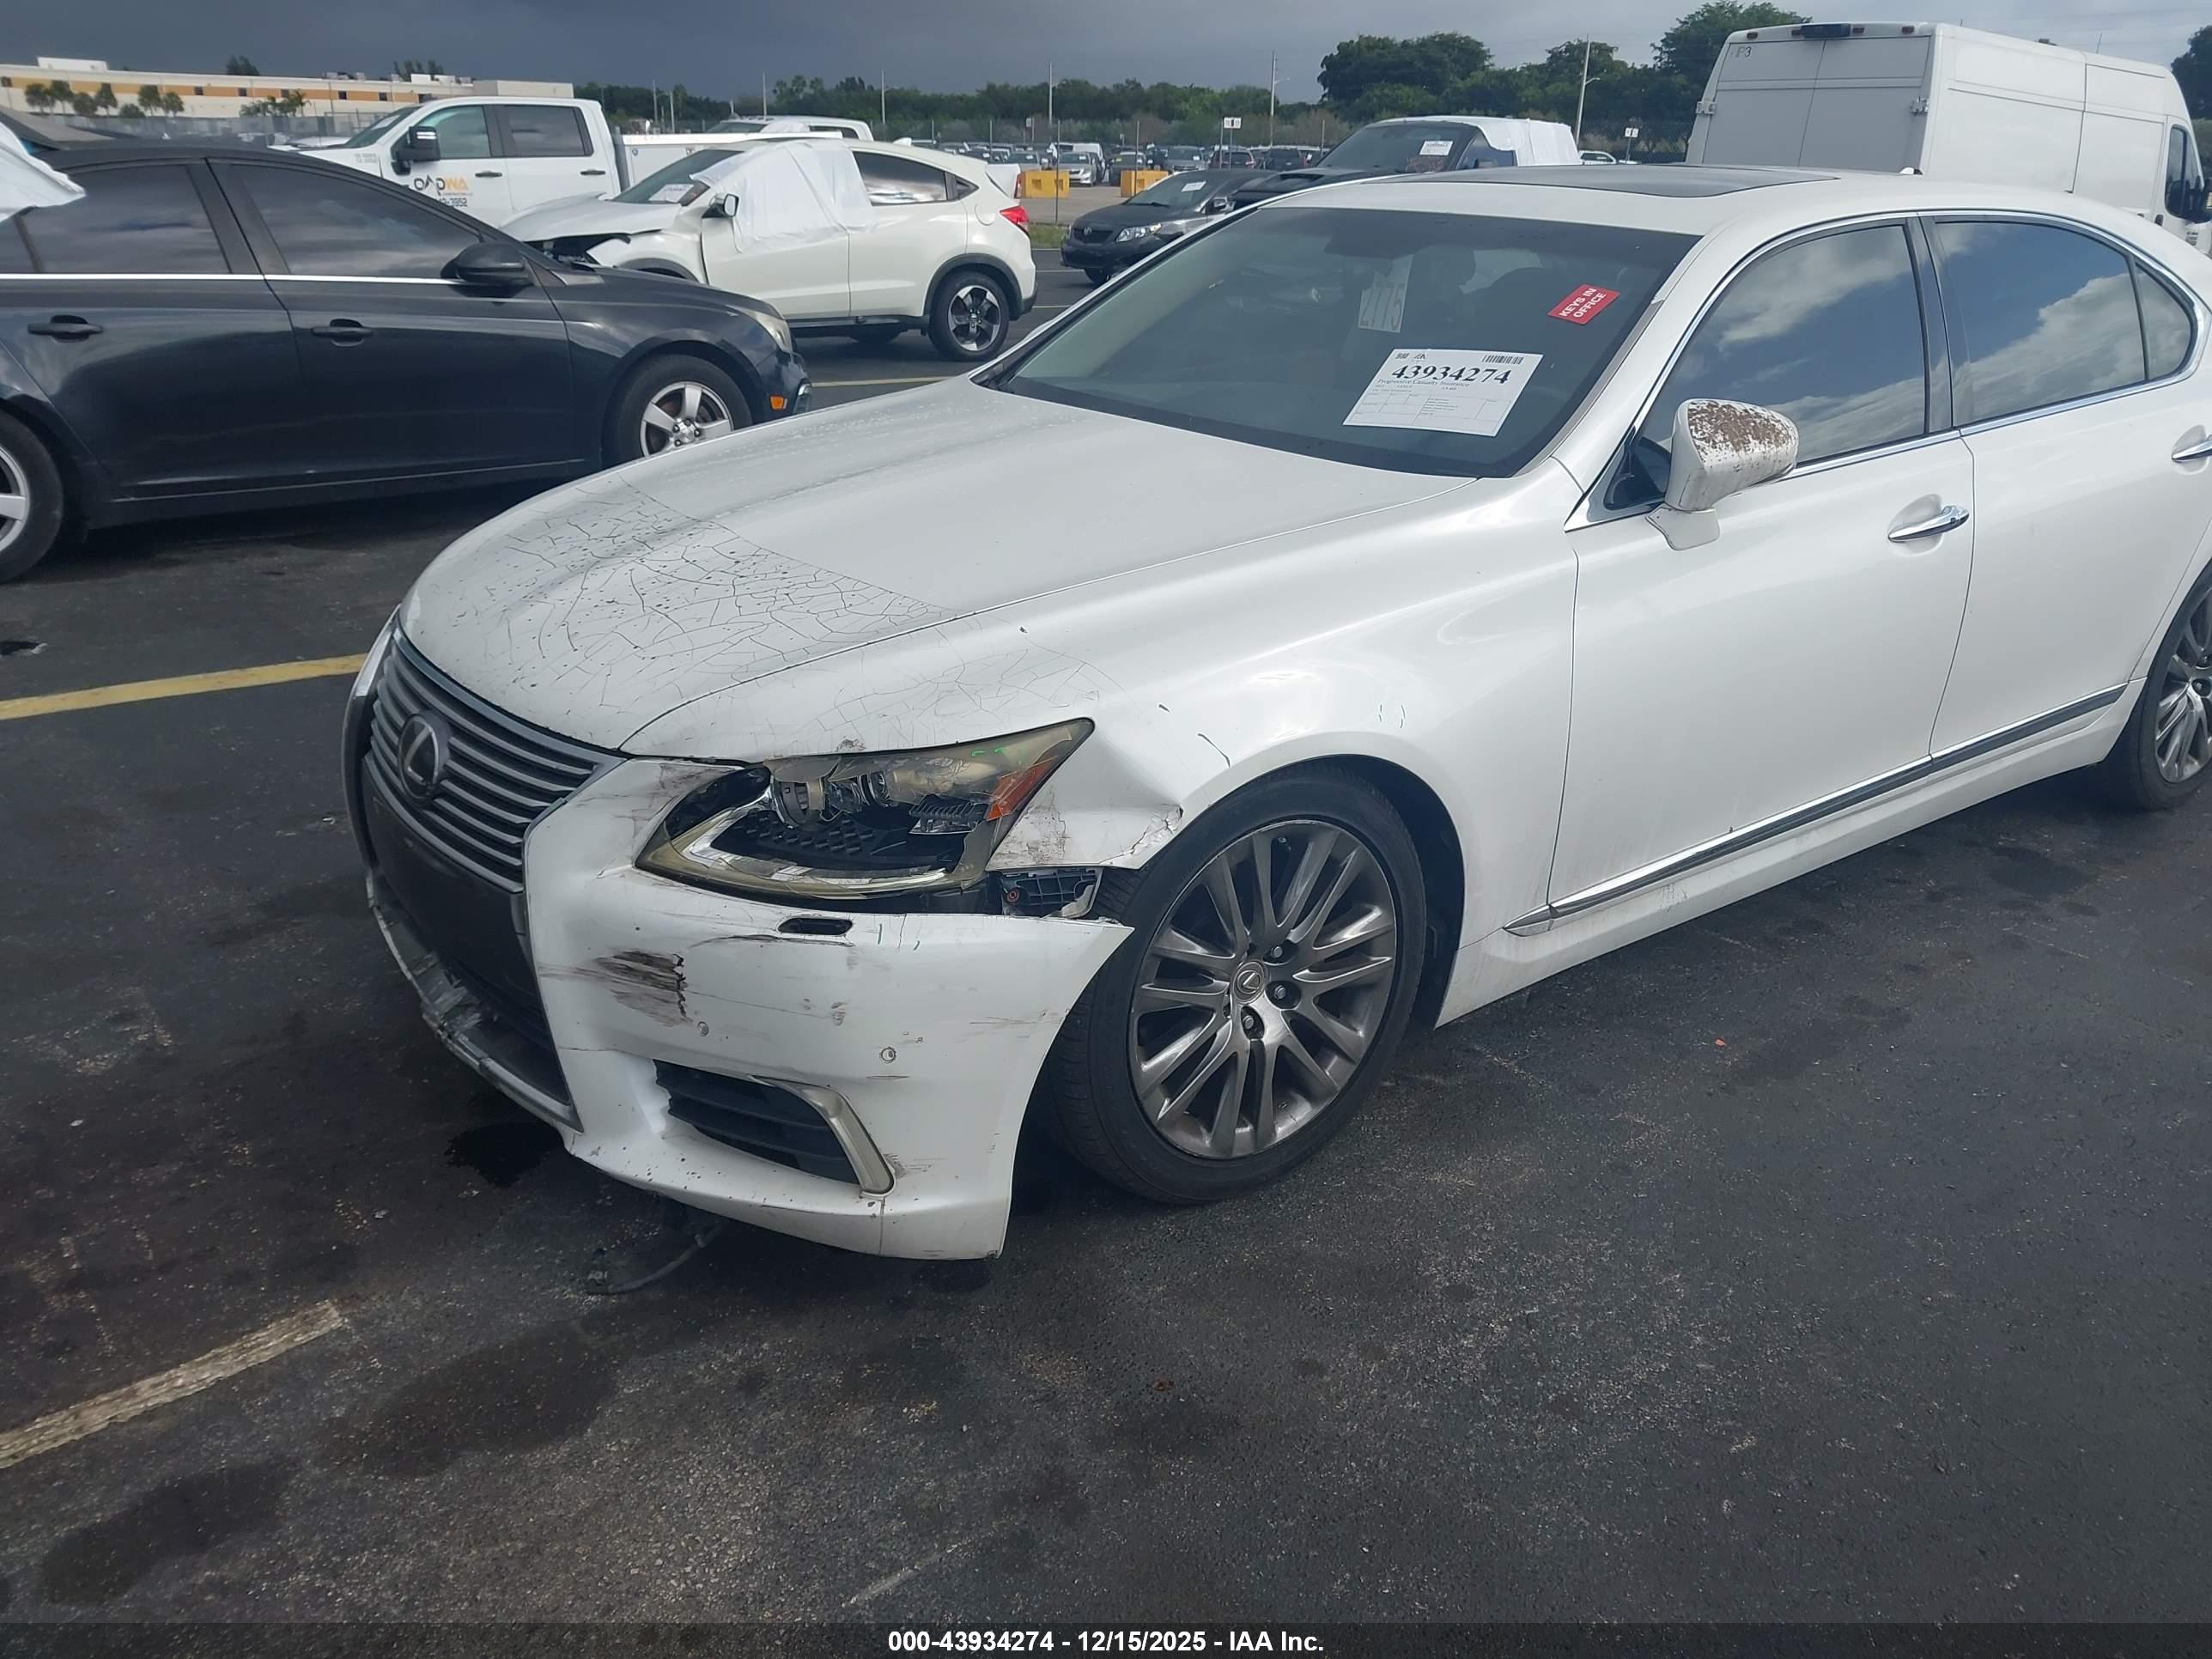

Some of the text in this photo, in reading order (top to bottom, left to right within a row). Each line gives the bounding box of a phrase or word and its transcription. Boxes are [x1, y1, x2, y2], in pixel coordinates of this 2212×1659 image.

[1559, 288, 1597, 317] KEYS IN
[1573, 292, 1607, 318] OFFICE
[1391, 364, 1512, 385] 43934274
